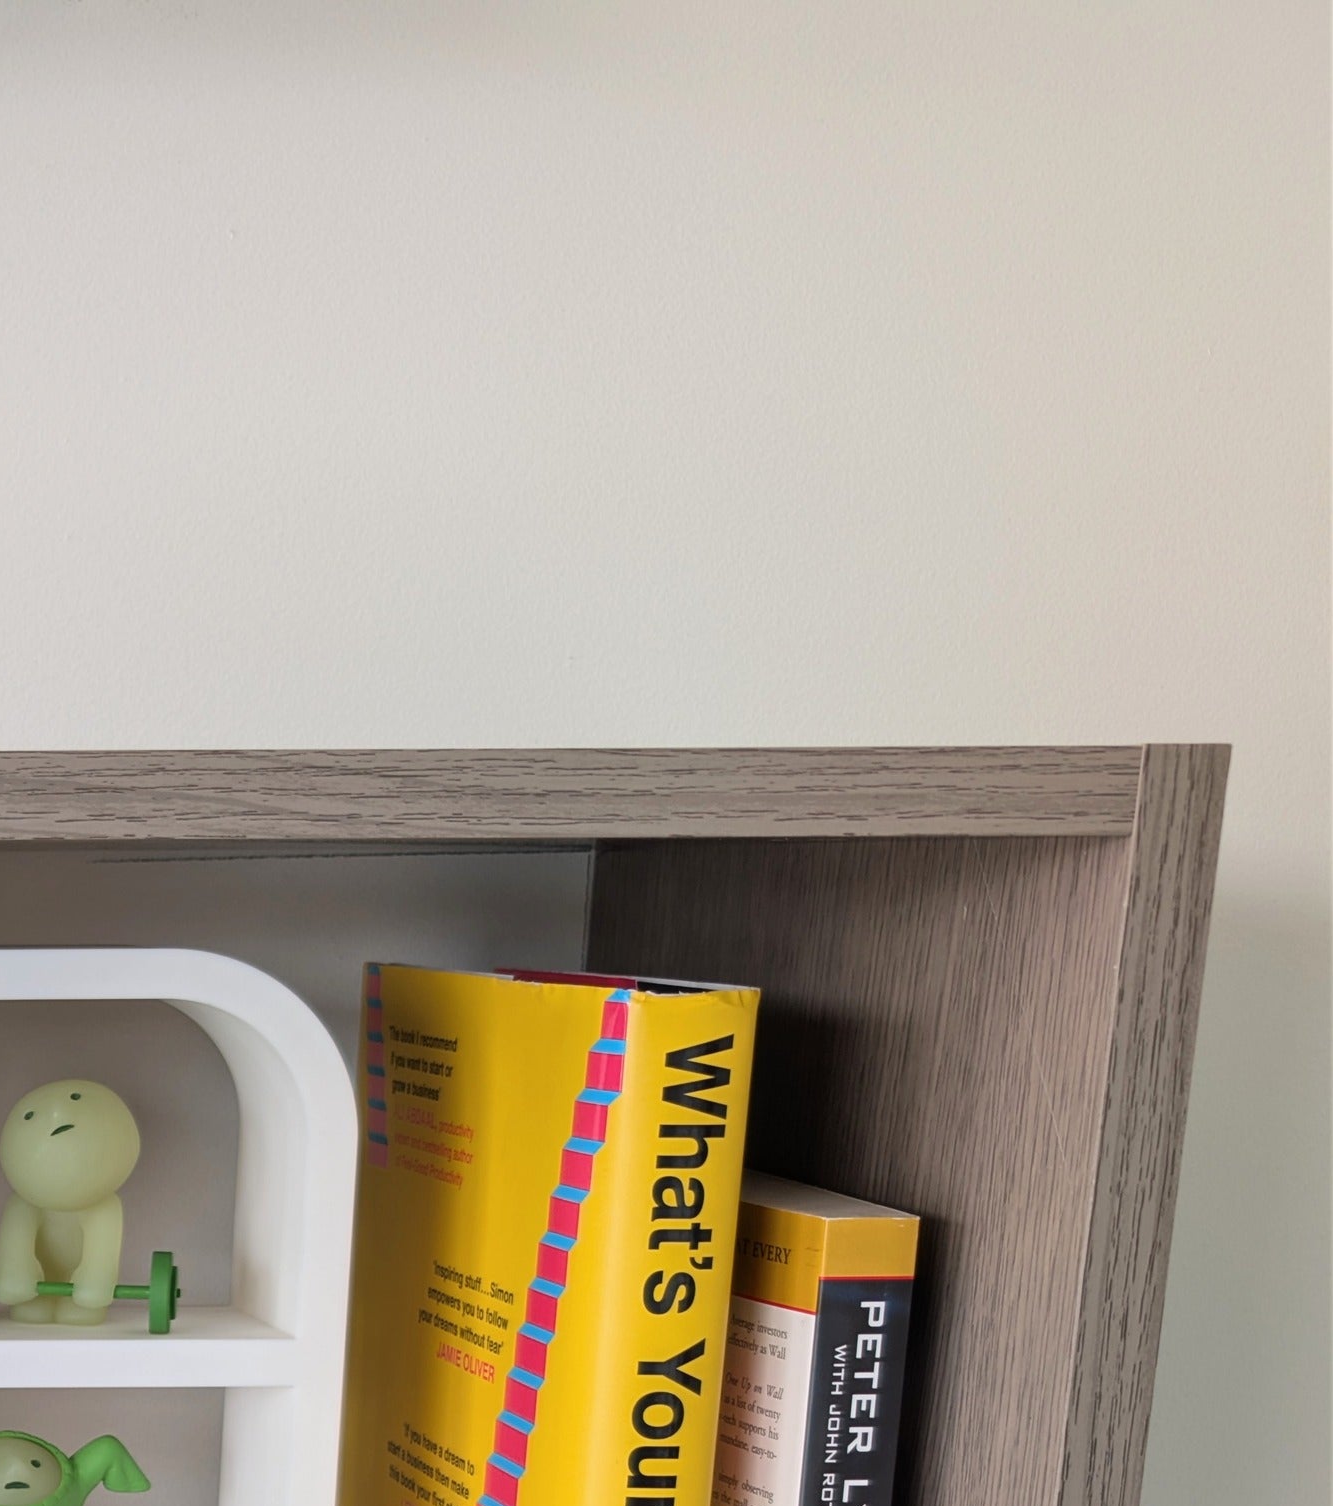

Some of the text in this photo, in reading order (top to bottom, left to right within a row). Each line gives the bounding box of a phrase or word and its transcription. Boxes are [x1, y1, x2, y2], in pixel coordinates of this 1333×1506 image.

[420, 1034, 457, 1052] recommend
[643, 1033, 735, 1316] What's
[753, 1241, 791, 1264] EVERY
[428, 1286, 509, 1330] empowers you to follow
[434, 1313, 458, 1336] dreams
[459, 1325, 485, 1348] without
[757, 1321, 787, 1340] investors
[436, 1342, 495, 1384] JAMIE OLIVER
[769, 1344, 786, 1360] Wall
[831, 1344, 848, 1395] WITH
[847, 1301, 886, 1454] PETER
[767, 1384, 784, 1400] Wall
[747, 1400, 756, 1413] of
[757, 1406, 781, 1423] twenty
[738, 1420, 779, 1440] supports his
[824, 1405, 841, 1463] JOHN
[444, 1449, 466, 1471] dream
[467, 1459, 475, 1476] to
[435, 1466, 449, 1490] then
[451, 1478, 470, 1500] make
[742, 1480, 774, 1504] observing
